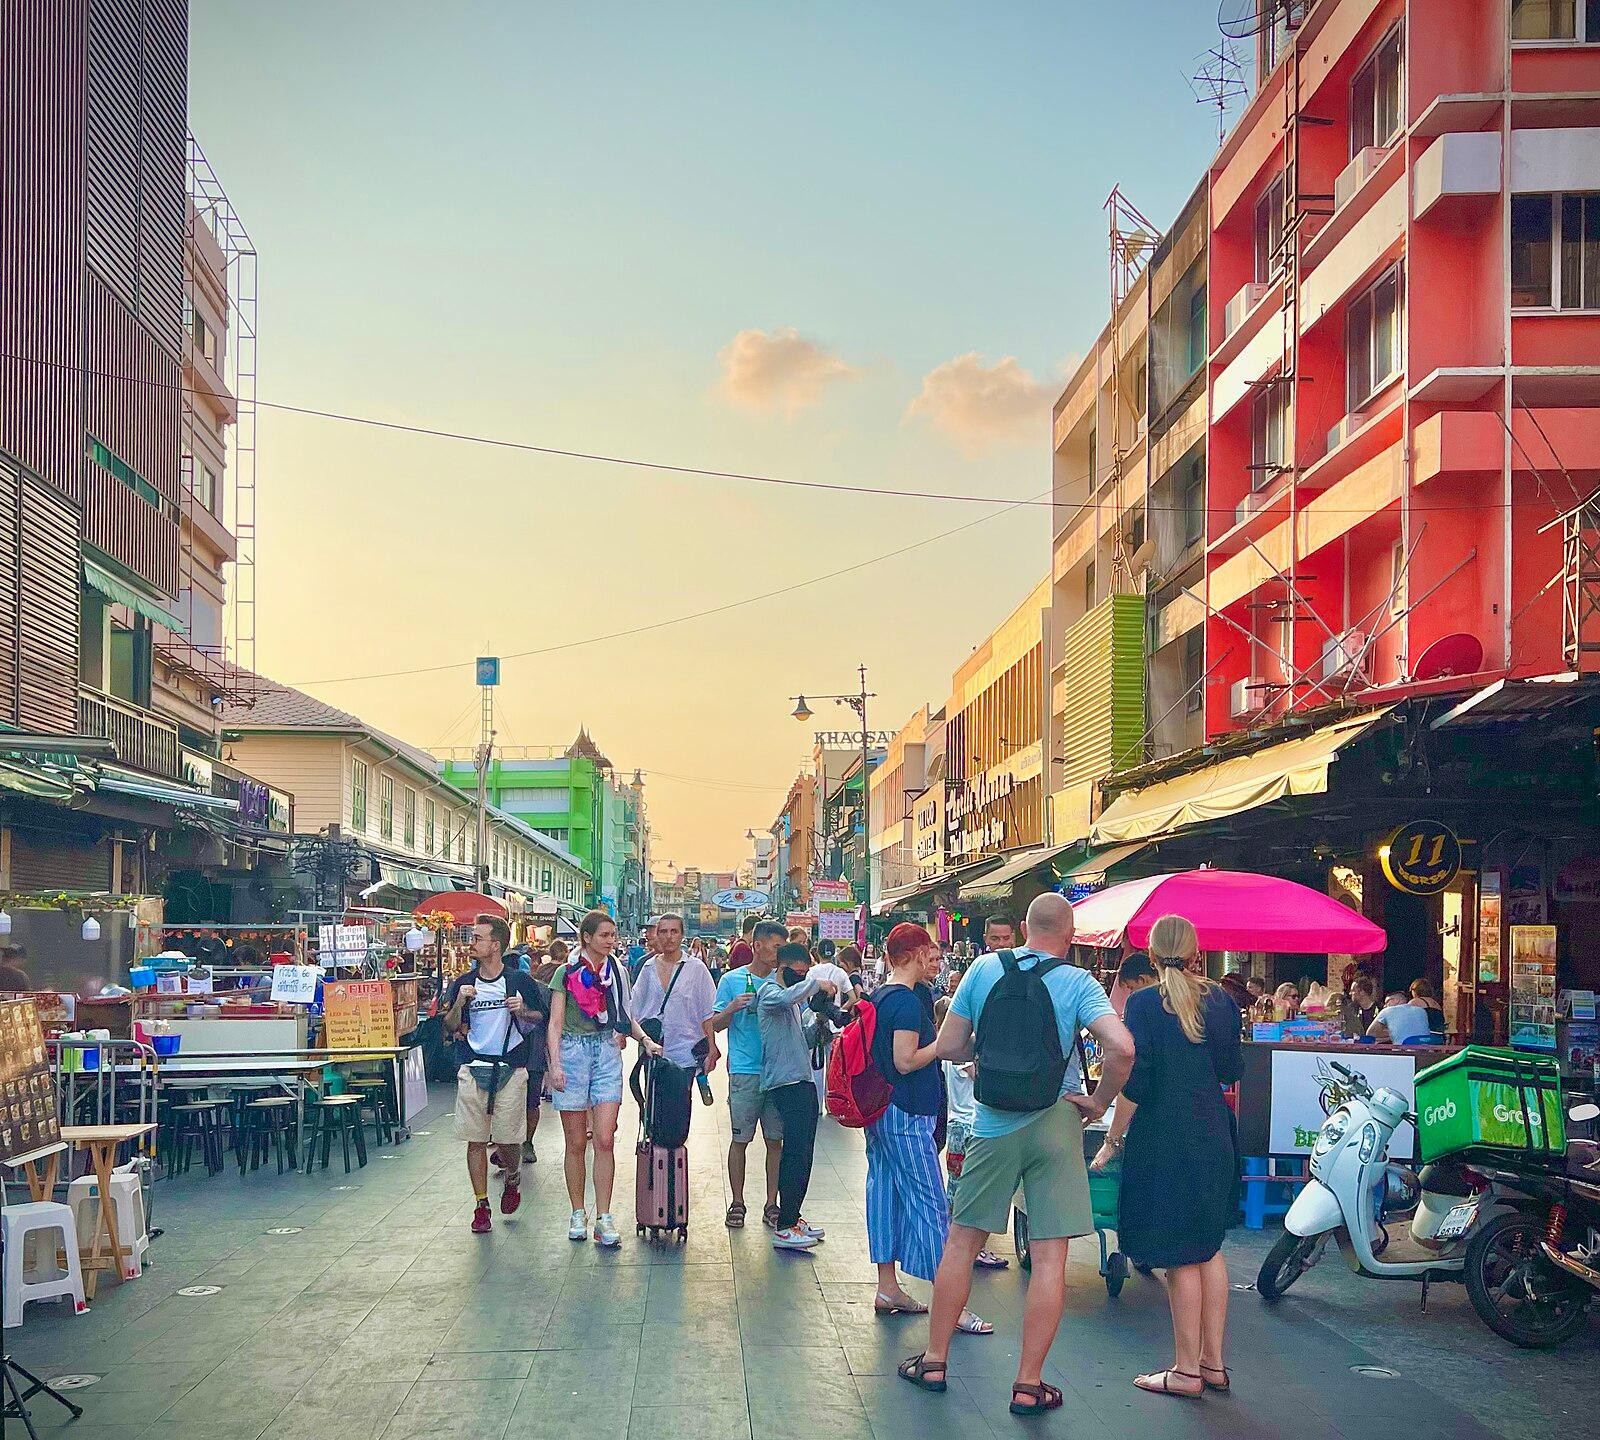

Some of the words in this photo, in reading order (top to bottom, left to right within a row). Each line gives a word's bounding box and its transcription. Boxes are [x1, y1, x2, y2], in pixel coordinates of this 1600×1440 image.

[1405, 834, 1446, 867] 11
[1424, 1097, 1456, 1126] Grab
[1493, 1104, 1541, 1126] Grab
